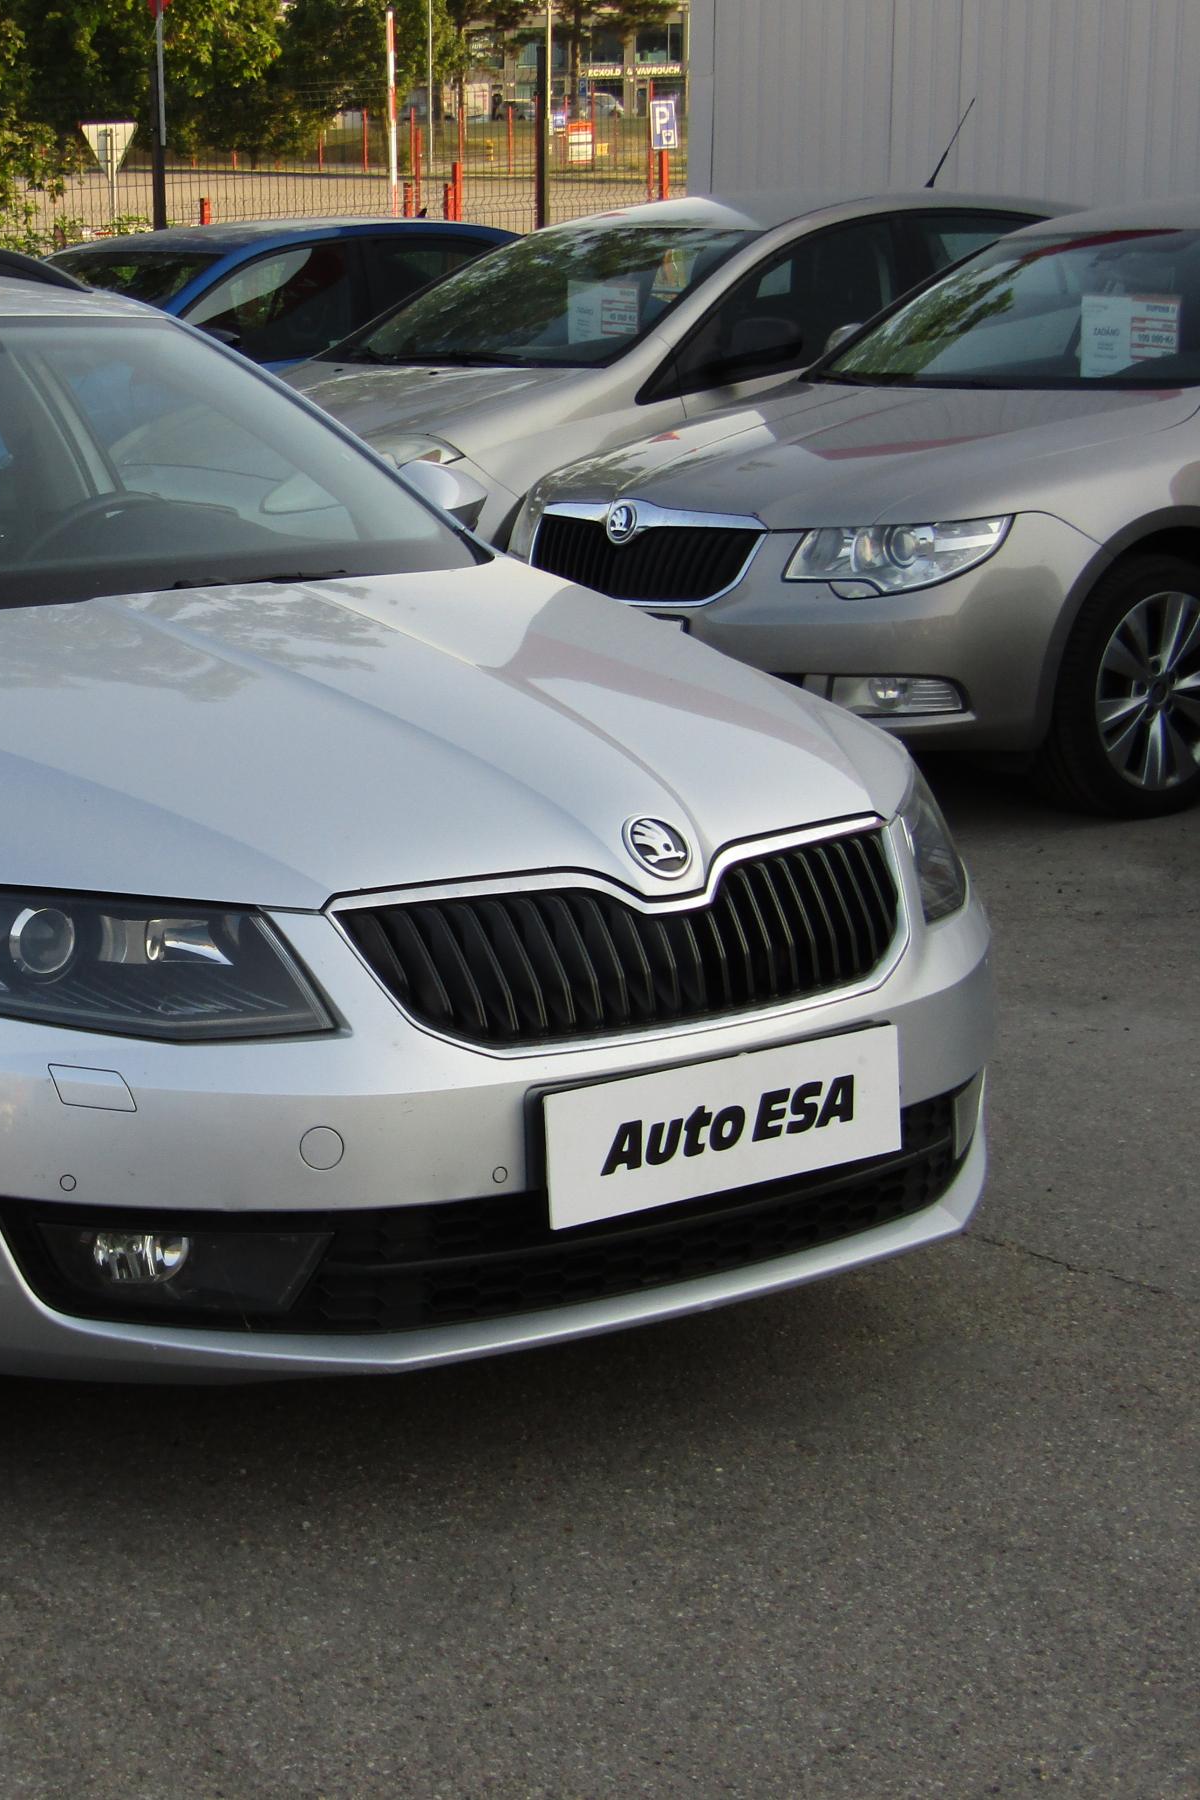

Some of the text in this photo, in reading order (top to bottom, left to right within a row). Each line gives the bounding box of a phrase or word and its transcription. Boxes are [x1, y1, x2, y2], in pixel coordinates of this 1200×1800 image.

[655, 106, 670, 135] P
[600, 1074, 855, 1176] Auto ESA
